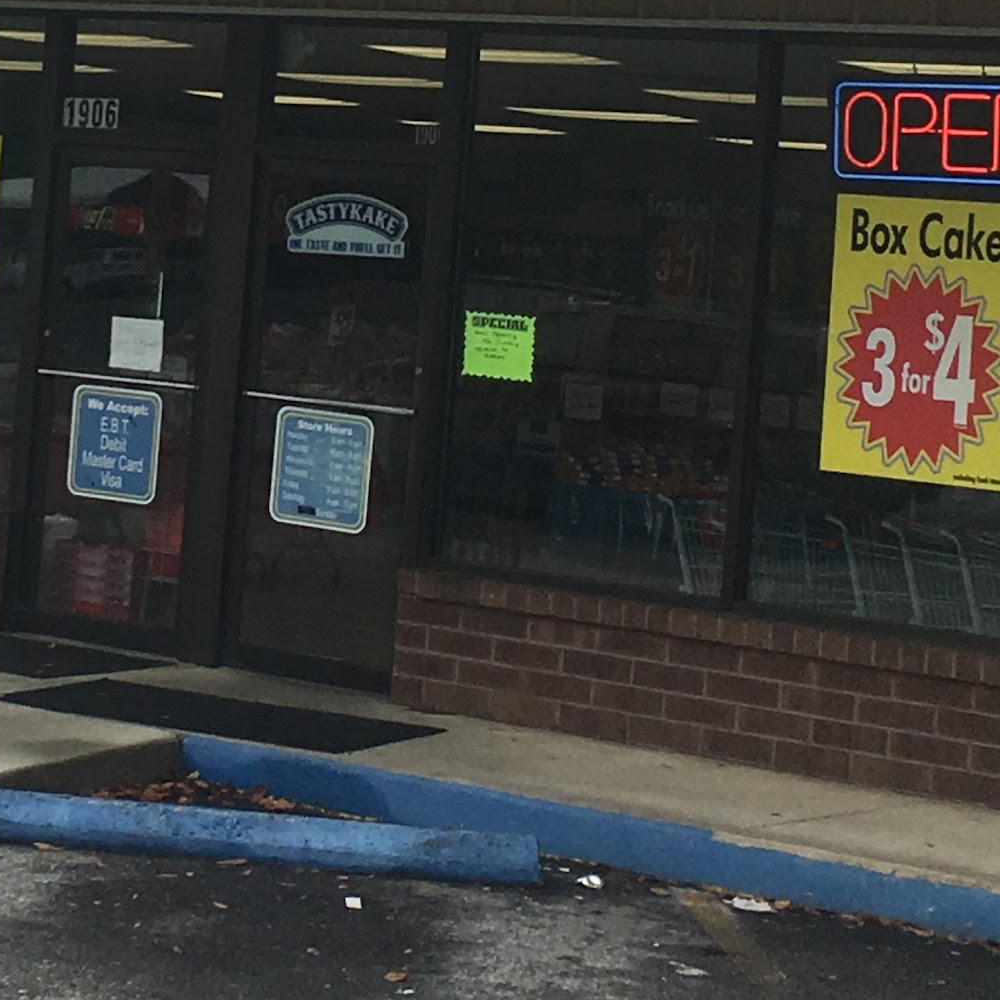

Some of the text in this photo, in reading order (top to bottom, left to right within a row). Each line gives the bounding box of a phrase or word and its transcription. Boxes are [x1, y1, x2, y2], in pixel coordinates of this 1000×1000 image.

[64, 98, 118, 128] 1906
[293, 201, 400, 236] TASTYKAKE
[850, 207, 1000, 264] Box Cake
[472, 316, 528, 332] SPECIAL
[860, 310, 976, 427] 3 for $4
[87, 398, 104, 411] We
[81, 450, 144, 473] Master Card
[100, 470, 123, 488] Visa
